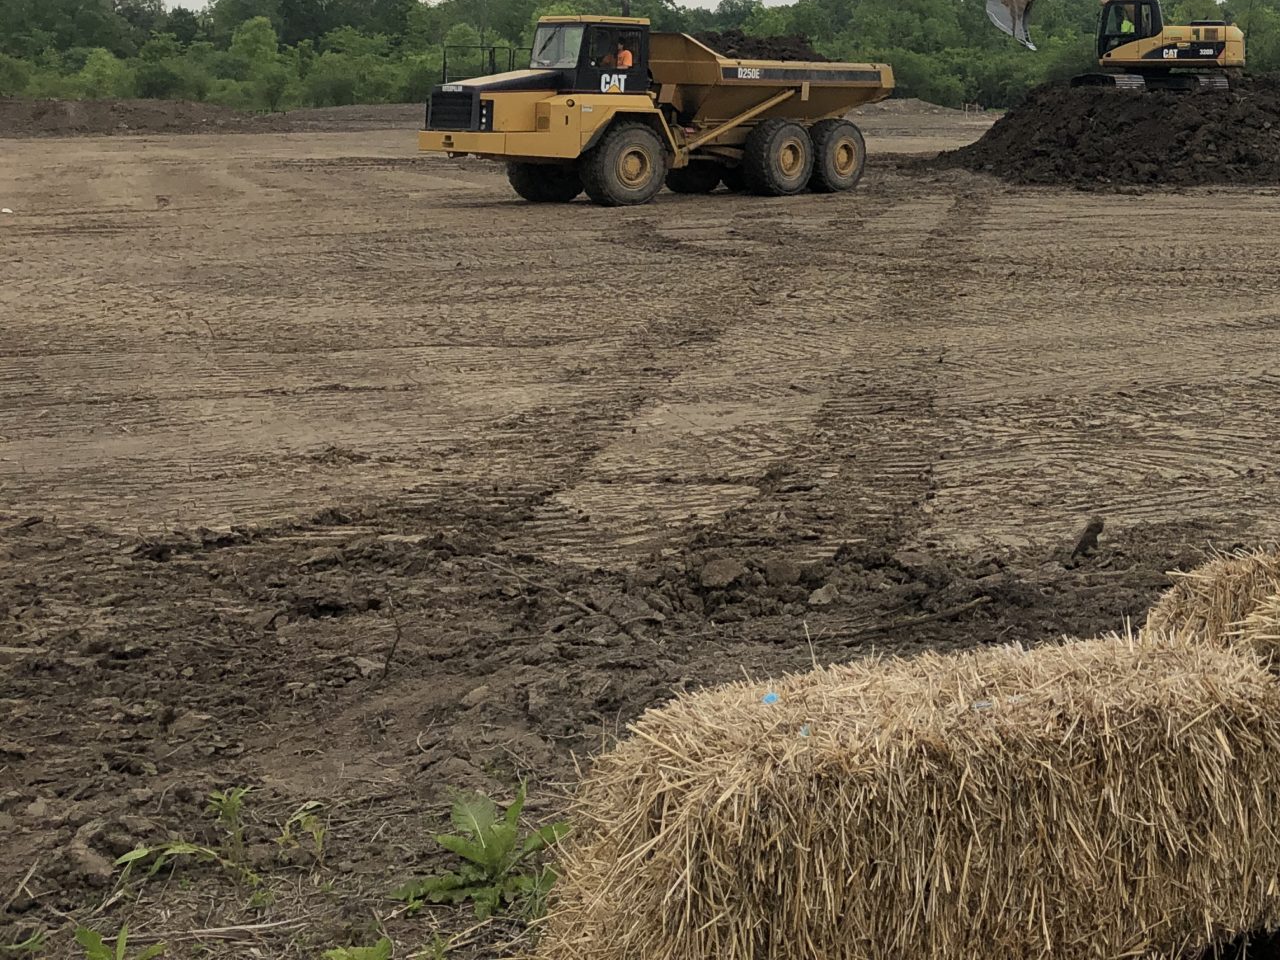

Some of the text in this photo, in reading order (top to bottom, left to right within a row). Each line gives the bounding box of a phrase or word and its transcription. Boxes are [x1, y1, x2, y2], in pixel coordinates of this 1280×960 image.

[1162, 48, 1178, 59] CAT
[737, 67, 760, 79] D250E
[600, 73, 627, 93] CAT
